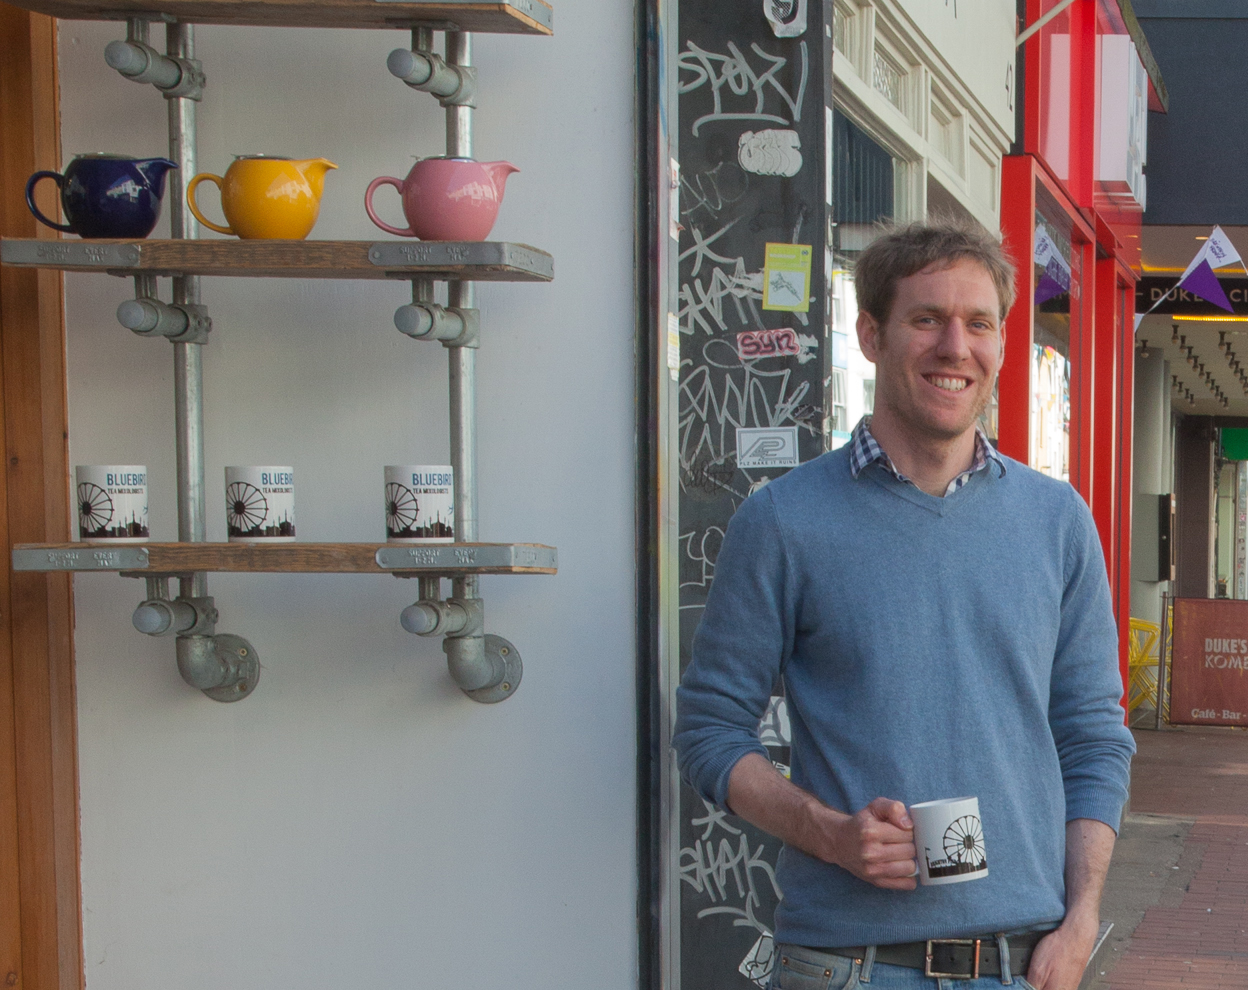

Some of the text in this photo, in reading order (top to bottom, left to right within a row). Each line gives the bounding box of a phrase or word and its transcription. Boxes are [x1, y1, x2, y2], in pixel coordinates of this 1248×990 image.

[1205, 638, 1247, 653] DUKE'S
[1191, 708, 1216, 719] Café
[1222, 709, 1241, 720] Bar
